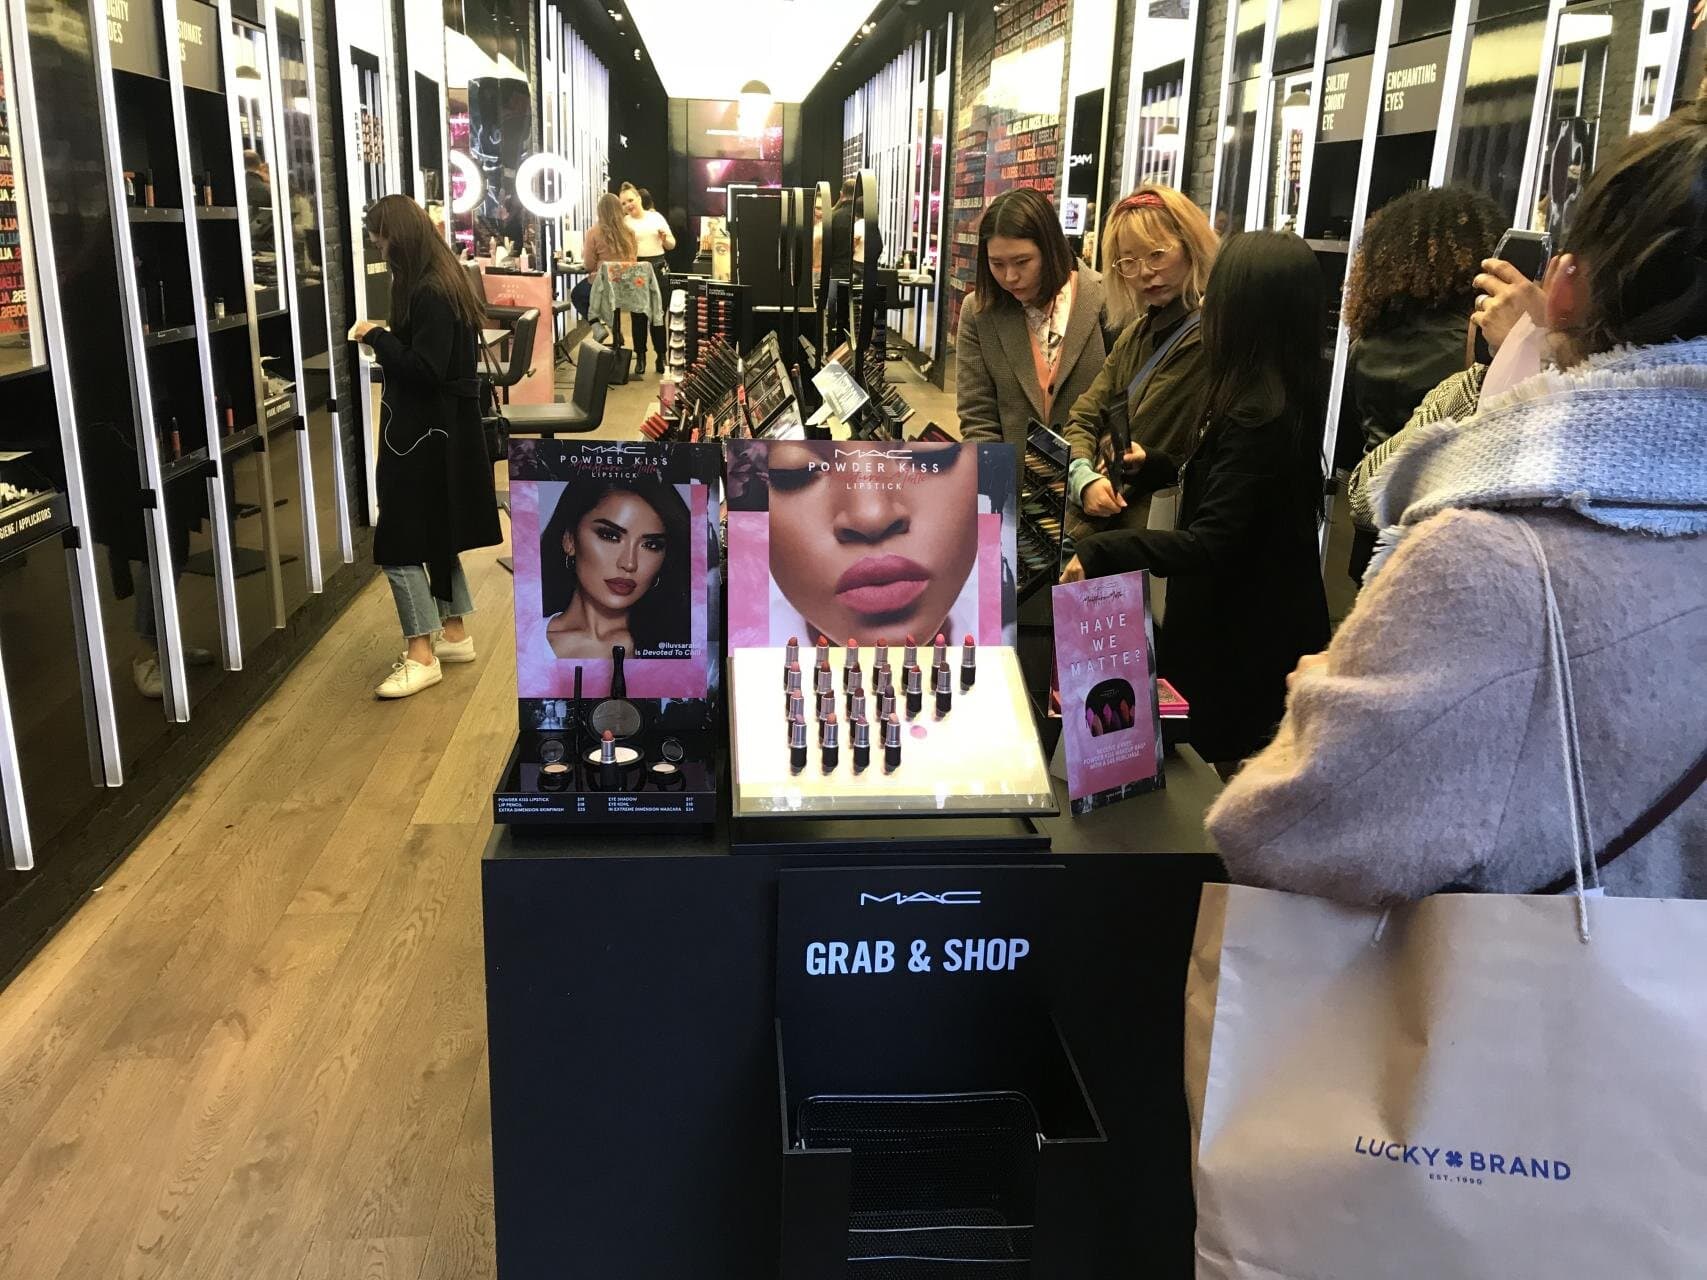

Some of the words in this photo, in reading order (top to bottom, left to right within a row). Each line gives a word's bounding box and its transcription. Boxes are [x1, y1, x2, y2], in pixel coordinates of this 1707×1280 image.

[1325, 72, 1350, 93] SULTRY
[1386, 63, 1437, 91] ENCHANTING
[1323, 92, 1346, 111] SMOKY
[1384, 91, 1404, 112] EYES
[1322, 113, 1335, 131] EYE
[581, 445, 646, 455] MAC
[835, 449, 912, 459] MAC
[560, 455, 624, 465] POWDER
[634, 457, 668, 466] KISS
[808, 461, 886, 473] POWDER
[900, 463, 940, 473] KISS
[19, 507, 52, 531] APPLICATORS
[1080, 613, 1127, 636] HAVE
[1092, 635, 1118, 652] WE
[1070, 649, 1141, 677] MATTE?
[861, 891, 982, 905] MAC
[806, 940, 895, 975] GRAB
[907, 939, 931, 973] &
[943, 938, 1030, 972] SHOP
[1354, 1135, 1441, 1167] LUCKY
[1470, 1151, 1572, 1181] BRAND
